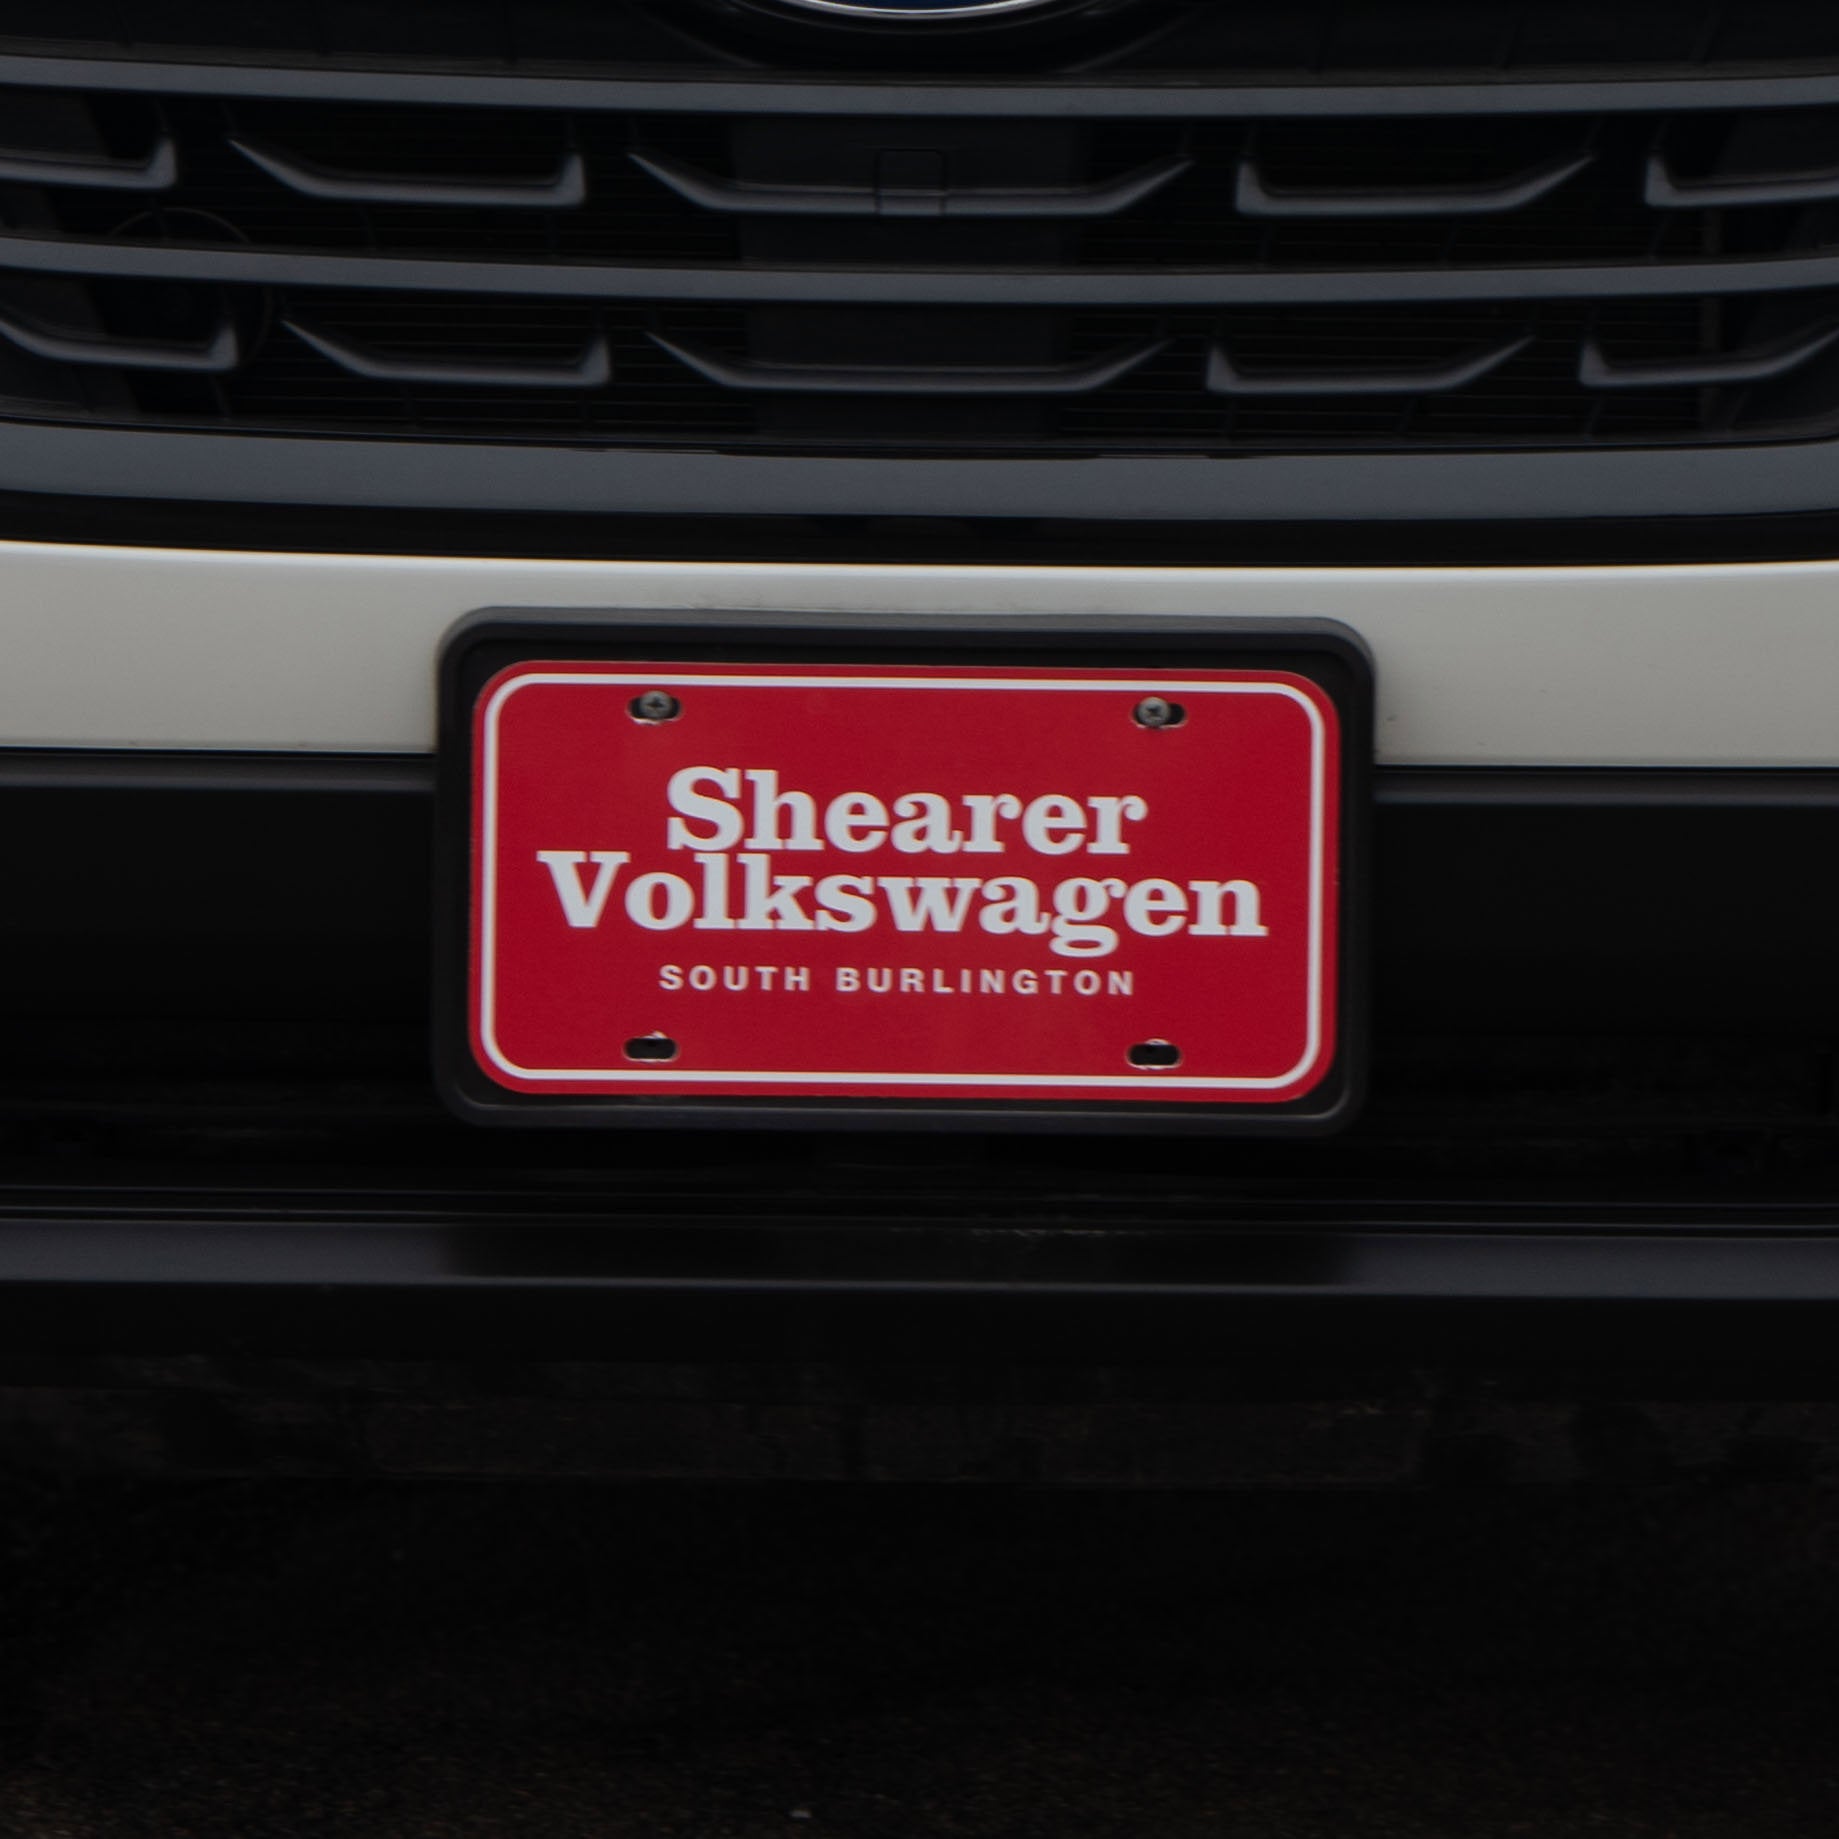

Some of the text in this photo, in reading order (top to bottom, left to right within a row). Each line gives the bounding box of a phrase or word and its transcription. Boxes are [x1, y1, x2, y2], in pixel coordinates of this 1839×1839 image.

[666, 765, 1148, 856] Shearer
[536, 850, 1269, 958] Volkswagen
[658, 964, 1134, 996] SOUTH BURLINGTON
